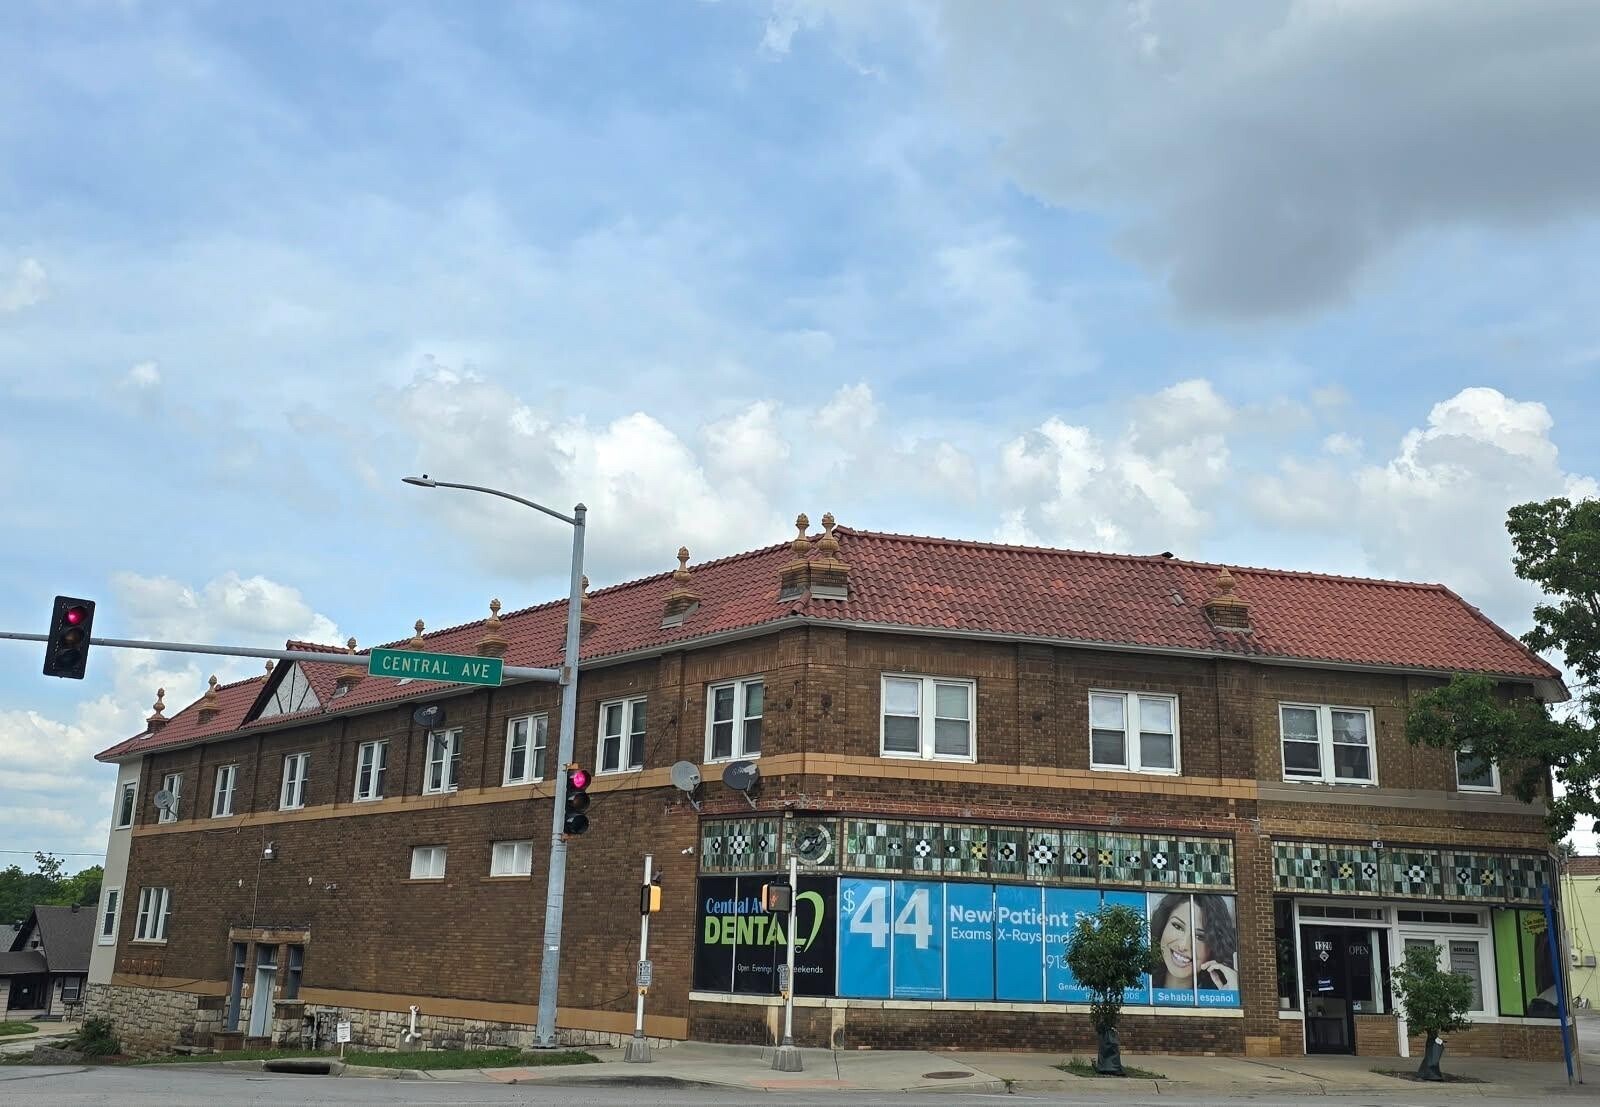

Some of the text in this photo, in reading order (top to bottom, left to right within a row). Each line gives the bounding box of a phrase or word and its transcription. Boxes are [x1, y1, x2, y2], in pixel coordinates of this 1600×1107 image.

[382, 656, 491, 678] CENTRAL AVE
[706, 897, 749, 914] Central
[950, 904, 995, 923] New
[998, 907, 1069, 927] Patient
[704, 912, 807, 946] DENTAL
[997, 928, 1042, 944] X-Rays
[1045, 931, 1070, 944] and
[1348, 945, 1369, 955] OPEN
[737, 963, 750, 972] Open
[751, 963, 773, 975] Evenings
[793, 965, 824, 974] eekends
[1158, 992, 1234, 1004] Se habla español
